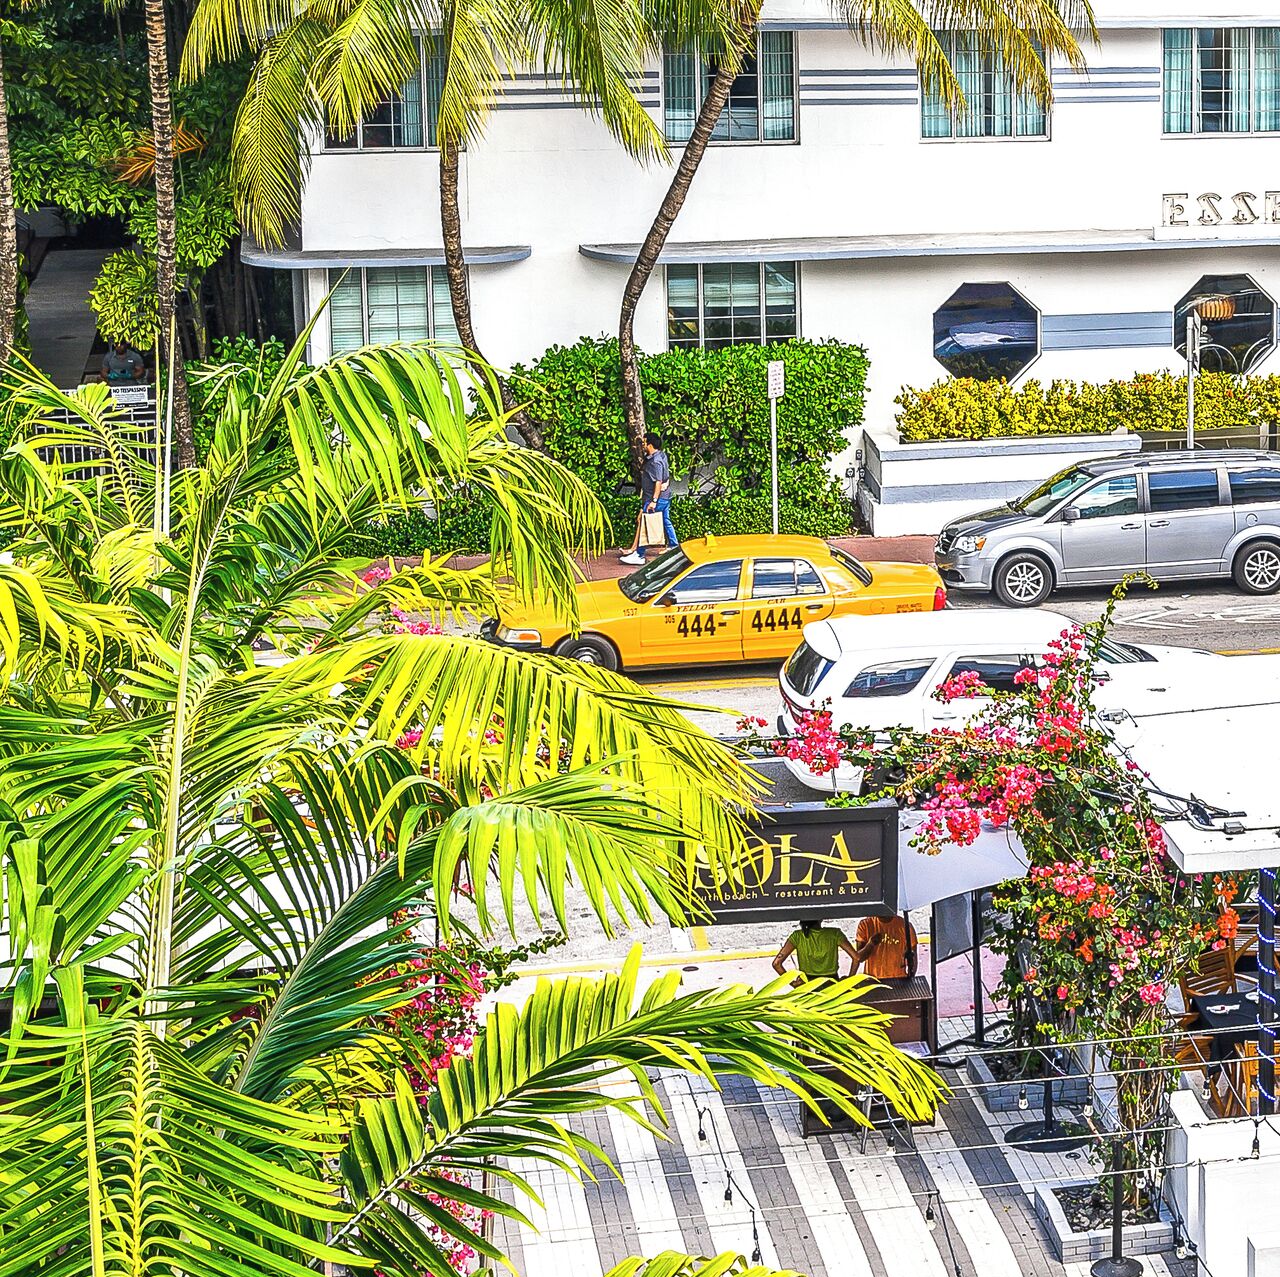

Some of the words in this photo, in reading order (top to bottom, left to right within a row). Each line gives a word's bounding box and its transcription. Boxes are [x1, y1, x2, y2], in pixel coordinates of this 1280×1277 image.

[676, 603, 718, 613] YELLOW
[752, 607, 803, 632] 4444
[775, 888, 833, 898] restaurant
[838, 886, 846, 895] &
[851, 886, 870, 894] bar
